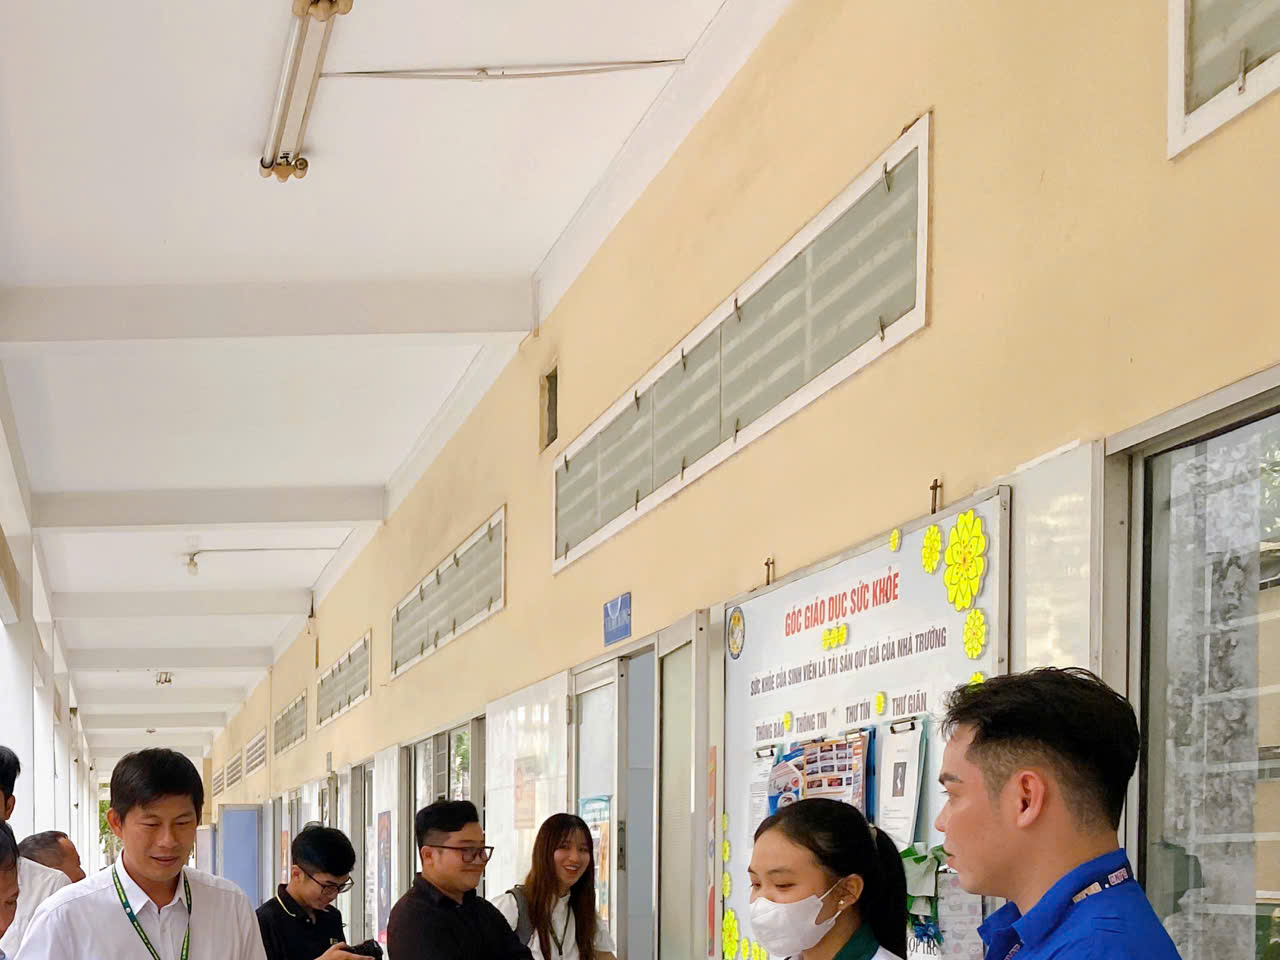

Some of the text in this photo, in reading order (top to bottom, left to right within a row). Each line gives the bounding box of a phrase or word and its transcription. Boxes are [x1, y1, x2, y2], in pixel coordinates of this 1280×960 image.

[785, 604, 802, 637] GÓC
[804, 597, 826, 630] GIÁO
[850, 580, 870, 615] SỨC
[872, 566, 900, 608] KHỎE
[881, 636, 896, 662] CỦA
[914, 626, 947, 653] TRƯỜNG
[892, 696, 906, 717] THƯ
